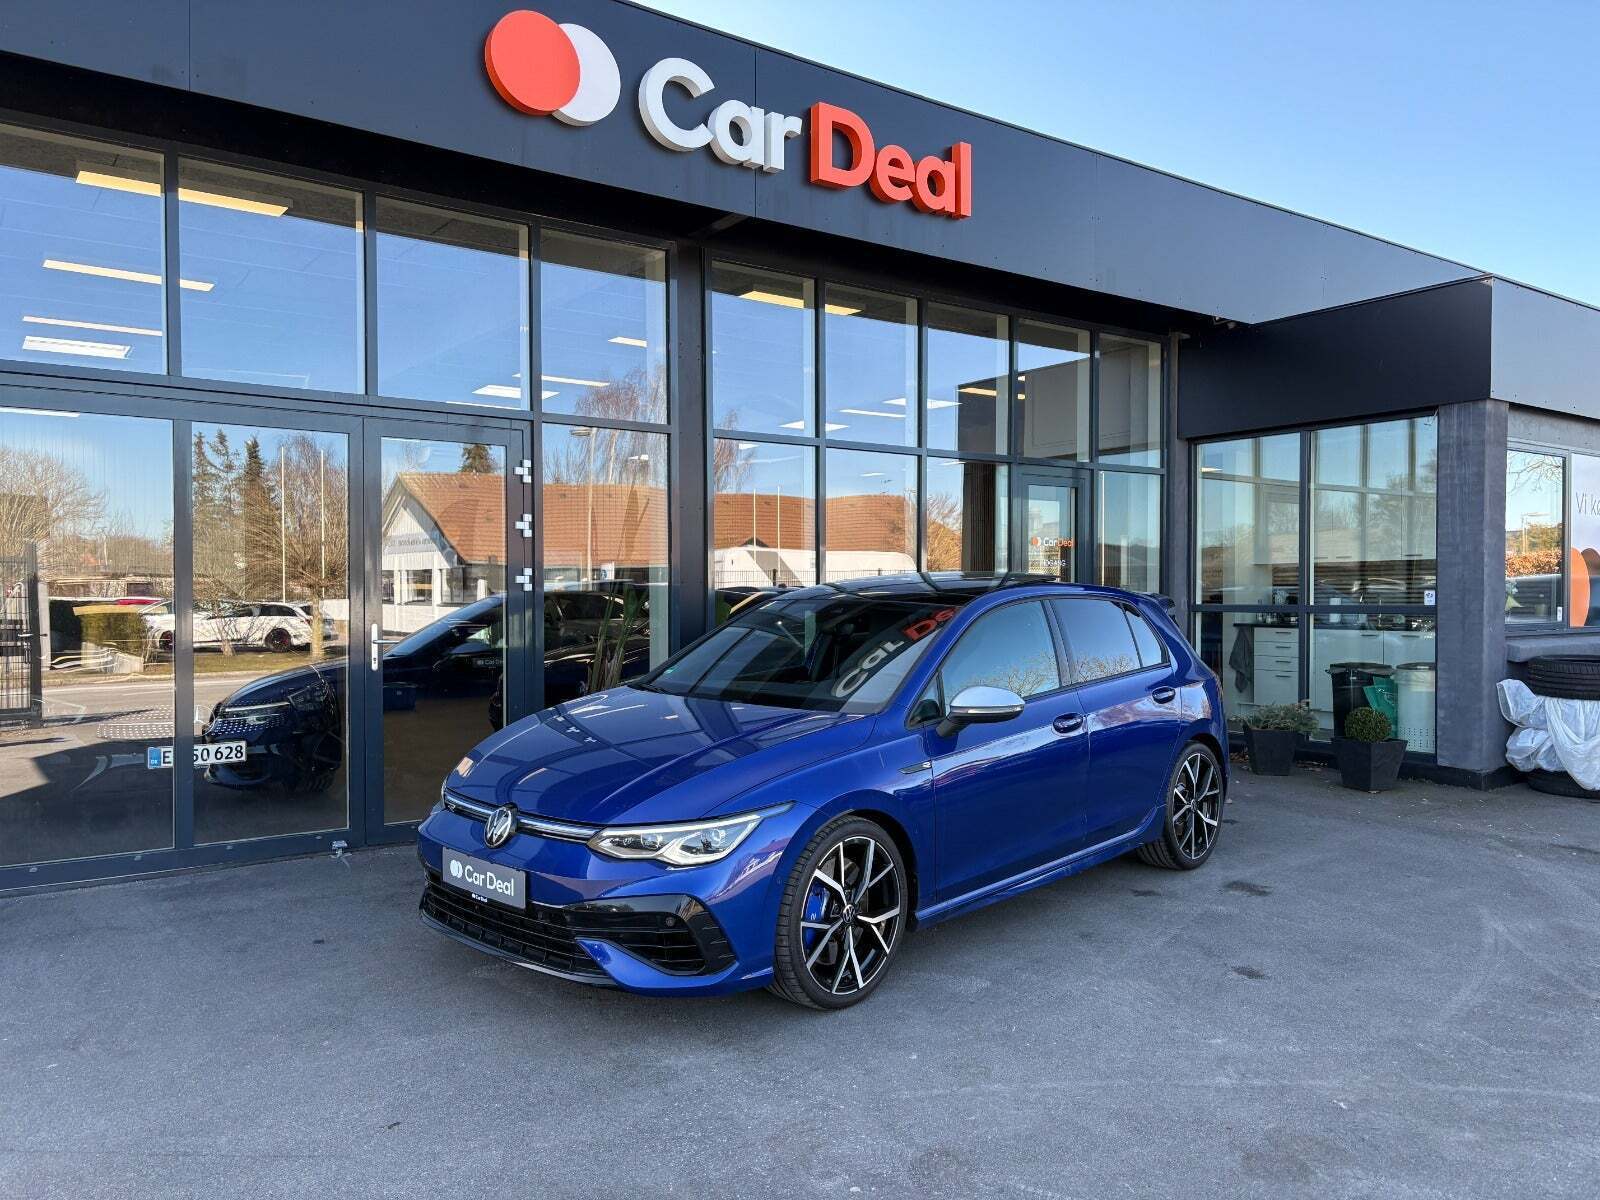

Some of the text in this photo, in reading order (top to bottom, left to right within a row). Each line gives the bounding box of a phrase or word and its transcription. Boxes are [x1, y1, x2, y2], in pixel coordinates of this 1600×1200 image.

[638, 57, 971, 219] Car Deal
[1575, 492, 1587, 515] Vi
[1044, 537, 1057, 547] Car
[193, 748, 210, 762] 50
[215, 745, 243, 760] 628
[465, 865, 514, 896] Car Deal
